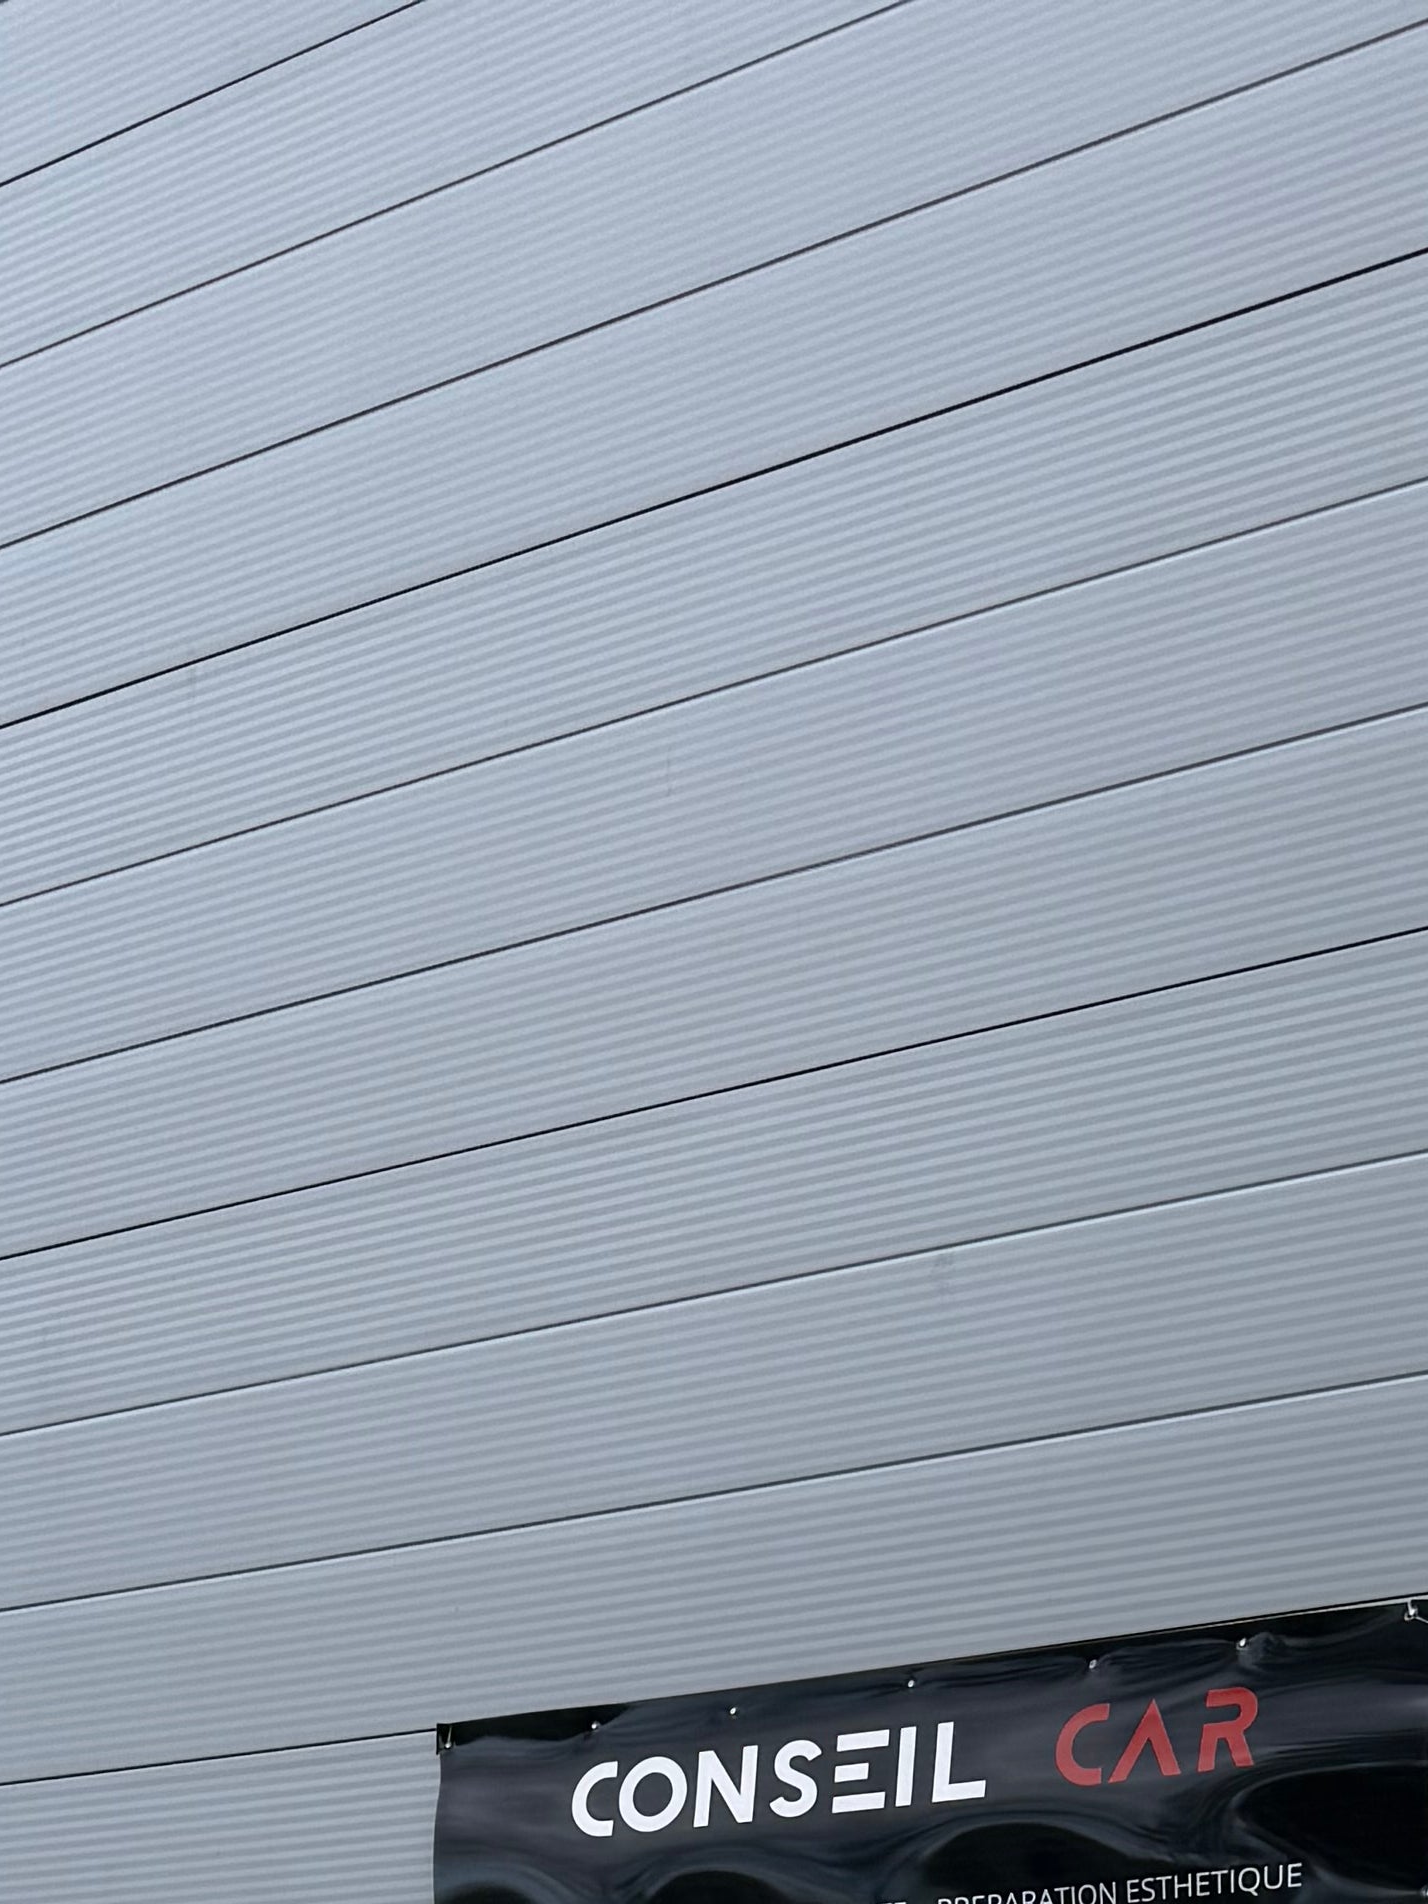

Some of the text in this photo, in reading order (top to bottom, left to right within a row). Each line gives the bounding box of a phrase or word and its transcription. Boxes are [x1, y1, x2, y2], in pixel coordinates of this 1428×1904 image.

[571, 1686, 1259, 1838] CONSEIL CAR
[1126, 1862, 1303, 1904] ESTHETIQUE
